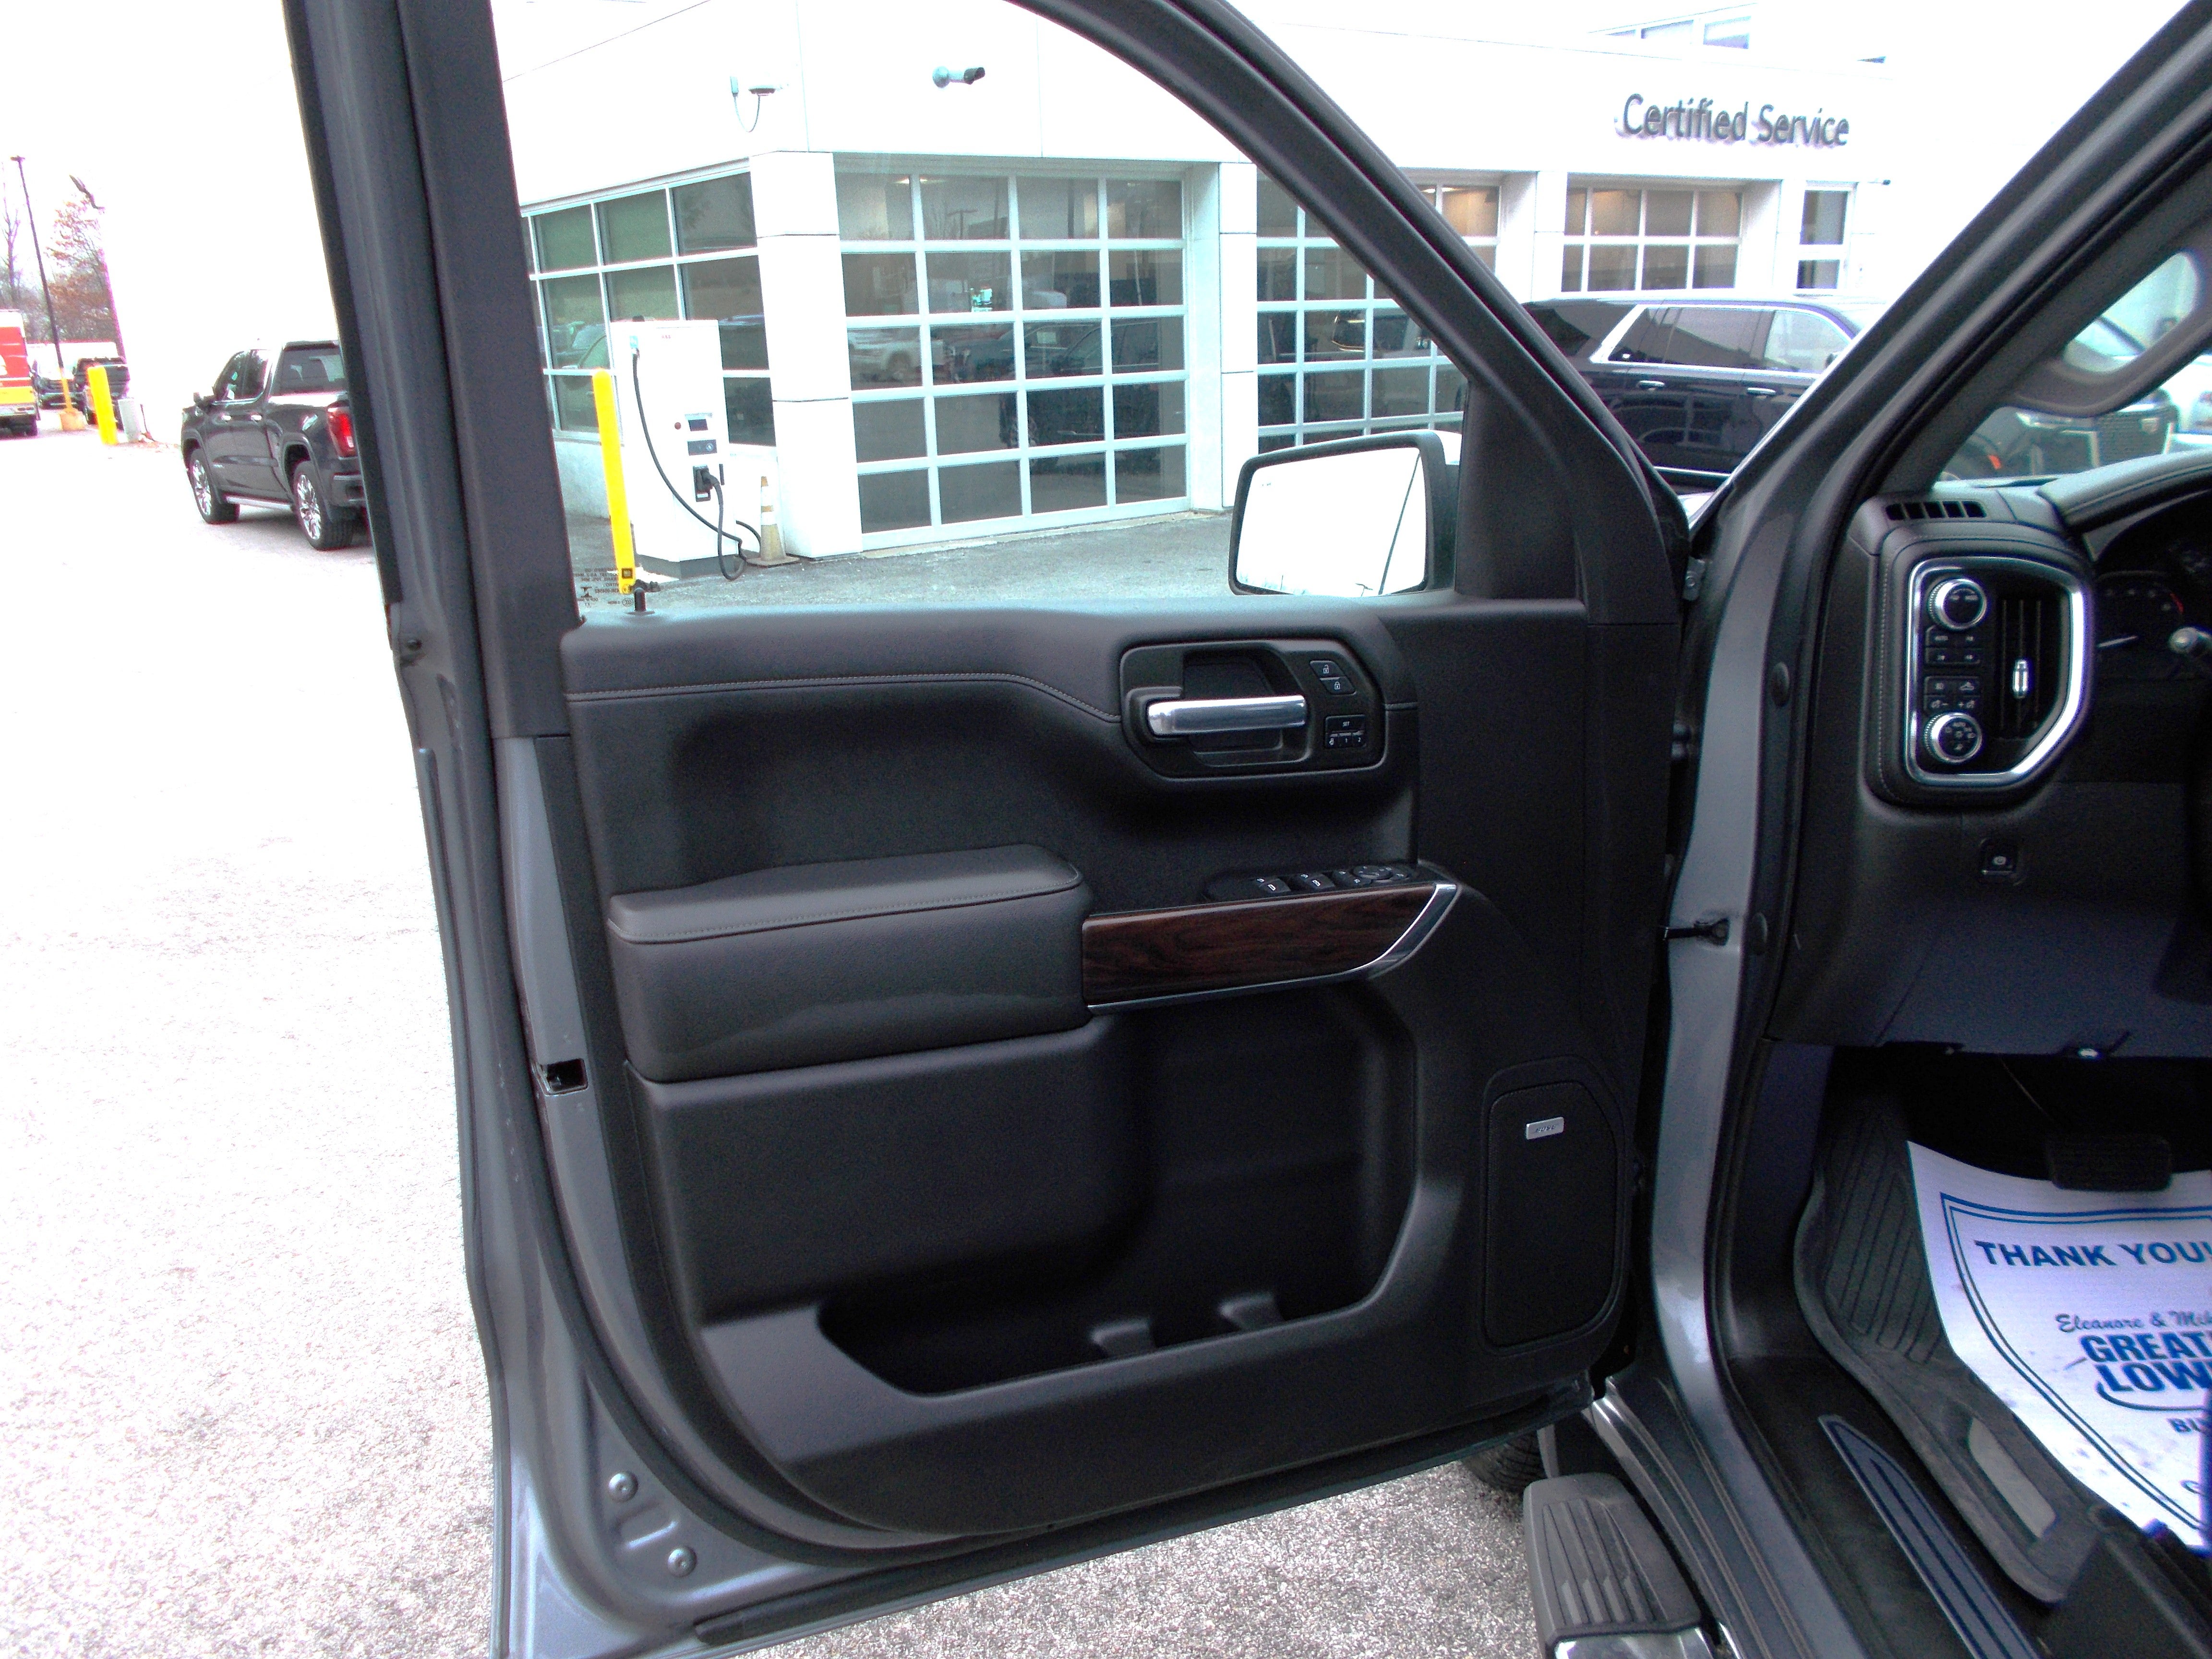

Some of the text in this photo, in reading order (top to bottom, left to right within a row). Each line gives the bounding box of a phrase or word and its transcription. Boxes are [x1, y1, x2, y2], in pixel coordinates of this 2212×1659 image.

[1622, 93, 1850, 146] Certified Service
[1973, 1240, 2117, 1267] THANK
[2055, 1312, 2143, 1333] Eleanore
[2150, 1311, 2167, 1327] &
[2079, 1332, 2212, 1362] GREAT
